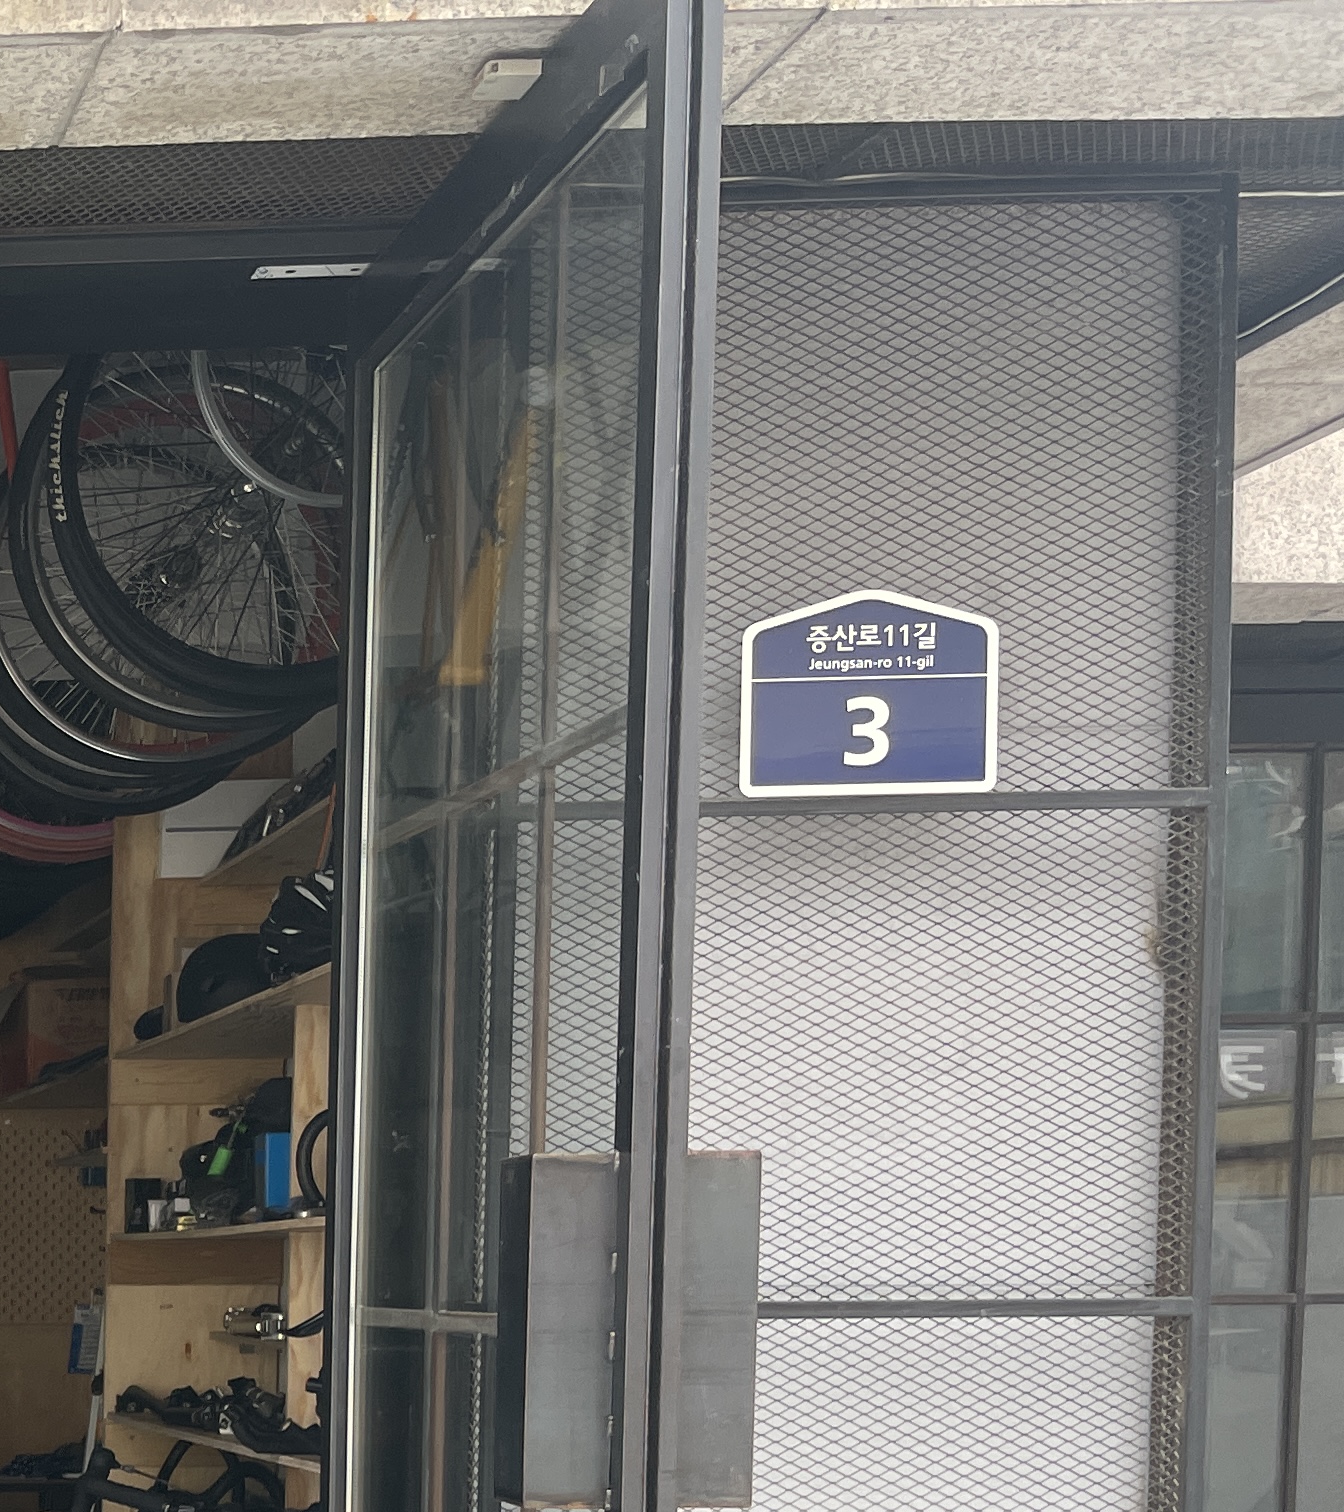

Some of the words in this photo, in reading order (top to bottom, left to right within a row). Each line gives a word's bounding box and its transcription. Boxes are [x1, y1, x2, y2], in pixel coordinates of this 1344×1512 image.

[806, 622, 936, 653] 증산로11길
[808, 656, 892, 672] Jeungsan-ro
[897, 654, 934, 671] 11-gil
[843, 695, 890, 767] 3
